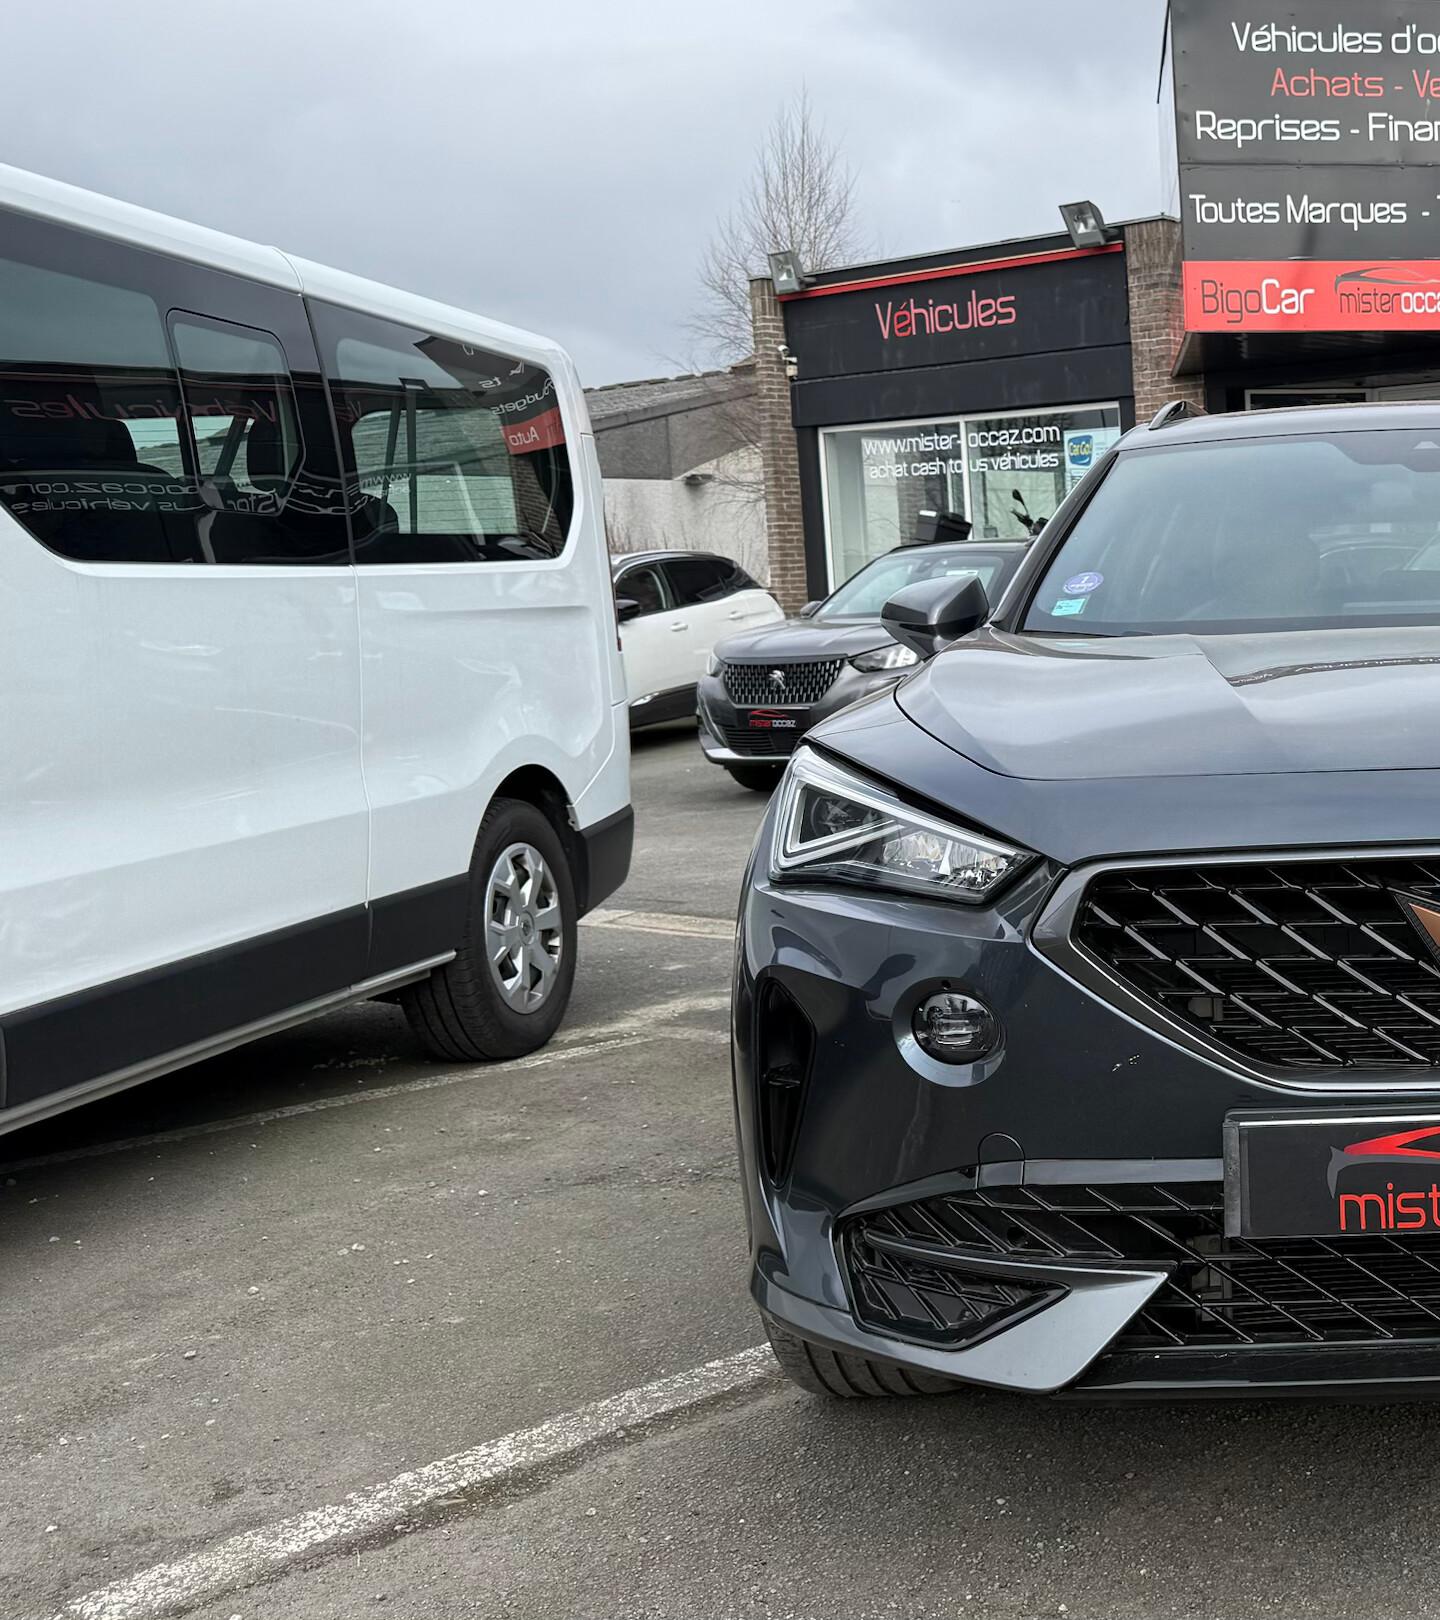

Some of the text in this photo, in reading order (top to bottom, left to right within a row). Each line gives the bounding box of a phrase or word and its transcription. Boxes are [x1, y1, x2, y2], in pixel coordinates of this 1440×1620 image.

[1231, 22, 1383, 53] Véhicules
[1271, 68, 1384, 97] Achats
[1196, 111, 1340, 148] Reprises
[1189, 194, 1280, 224] Toutes
[1287, 195, 1407, 231] Marques
[876, 290, 1017, 340] Véhicules
[1201, 279, 1315, 323] BigoCar
[870, 460, 908, 479] achat
[911, 458, 946, 477] cash
[990, 450, 1059, 470] véhicules
